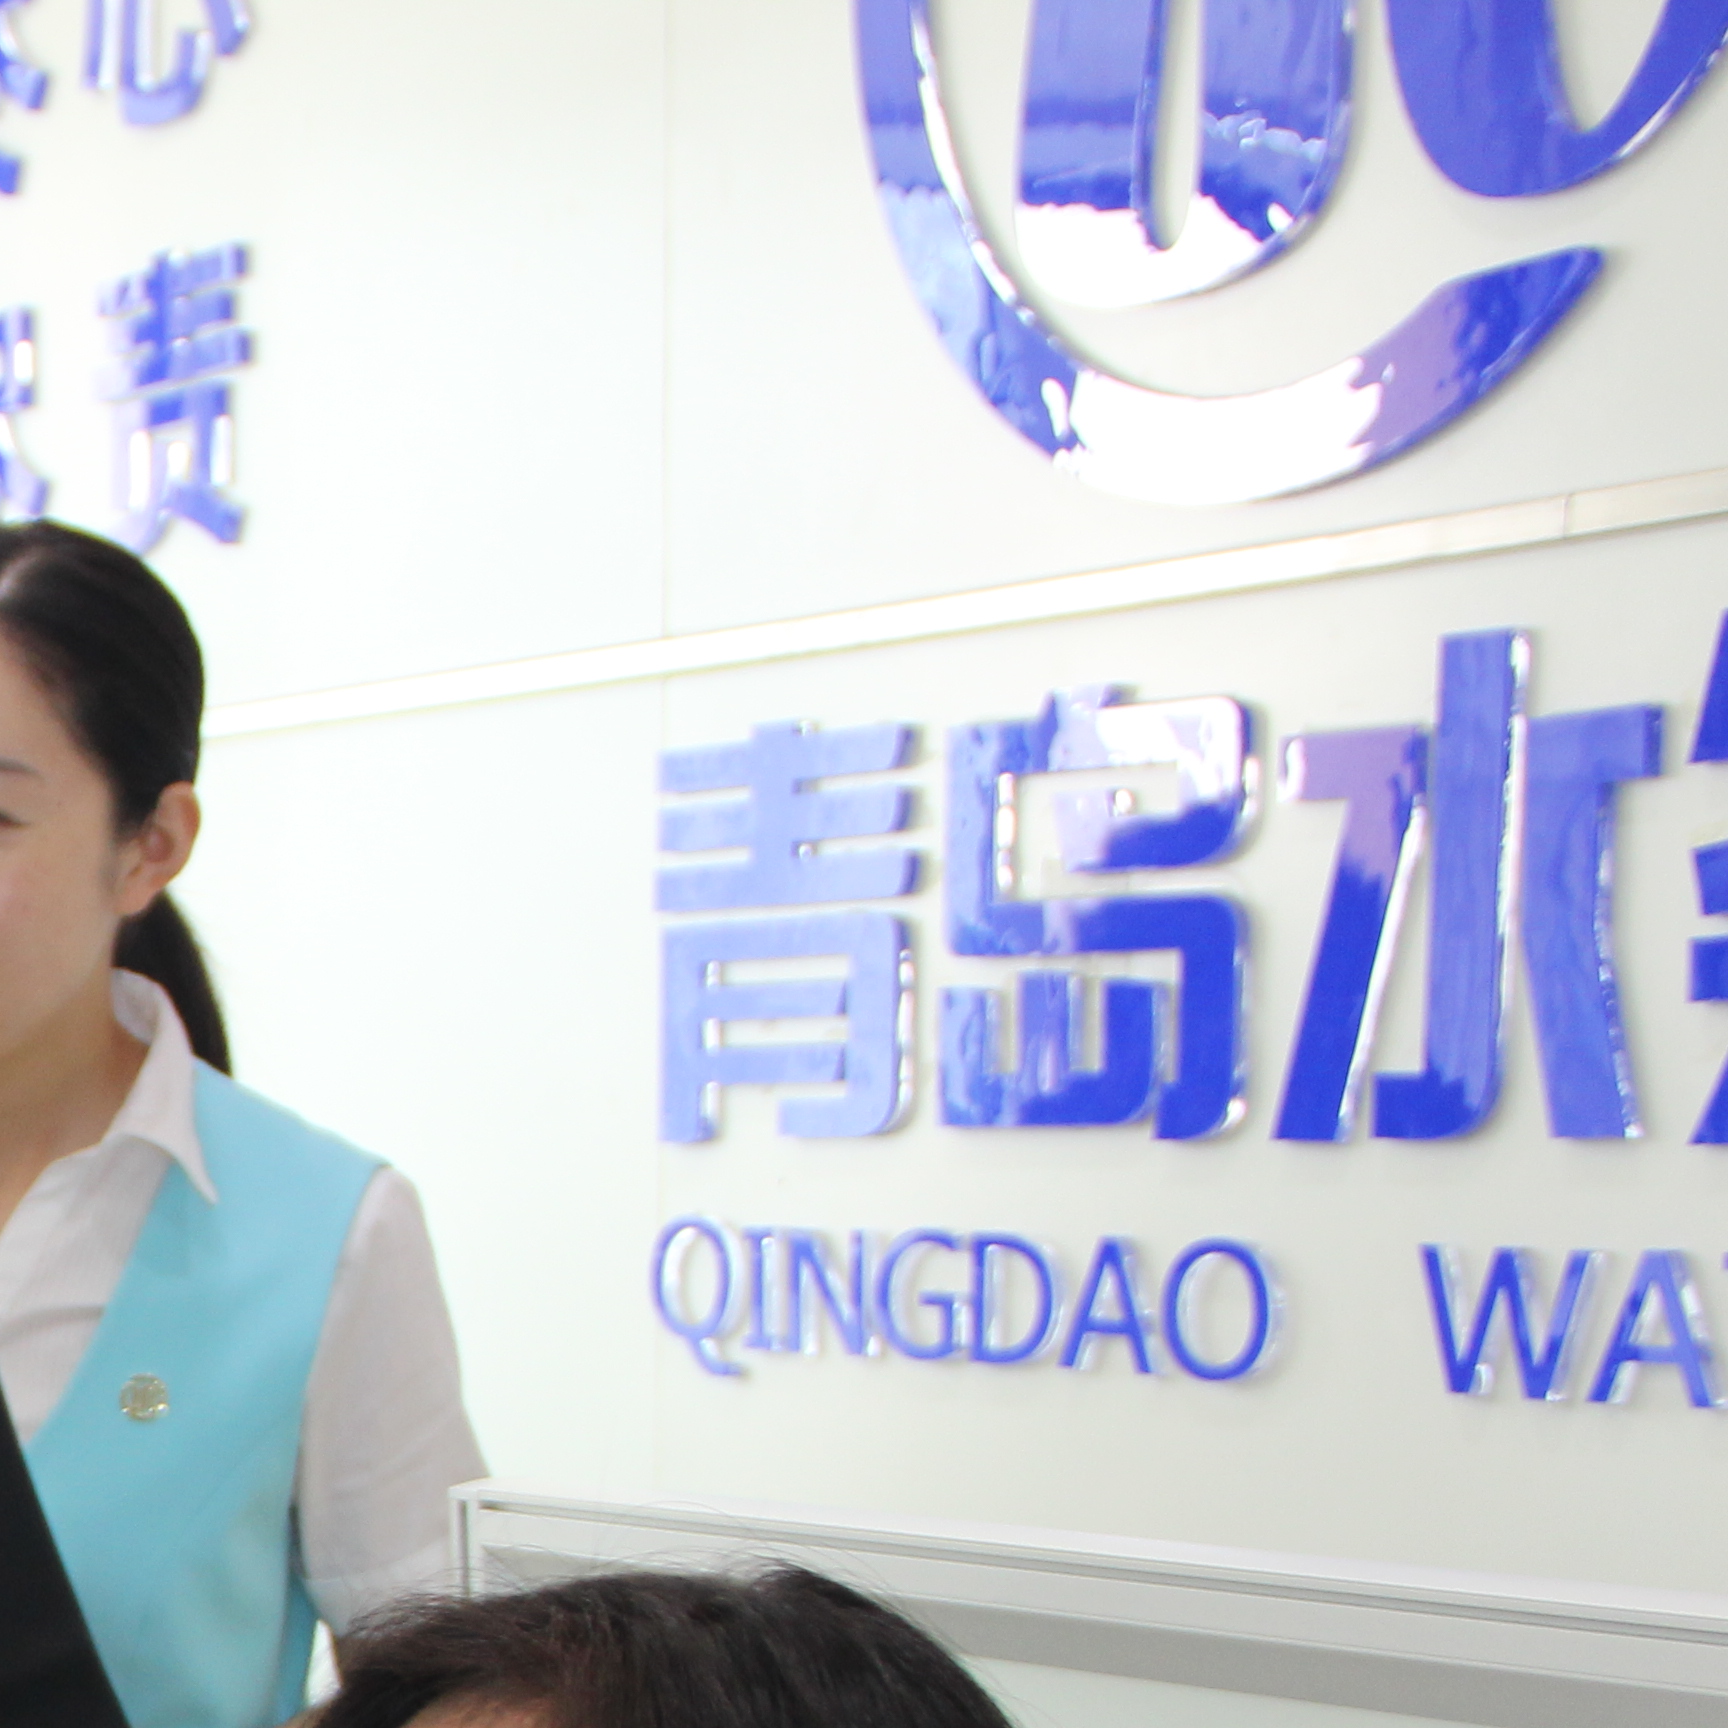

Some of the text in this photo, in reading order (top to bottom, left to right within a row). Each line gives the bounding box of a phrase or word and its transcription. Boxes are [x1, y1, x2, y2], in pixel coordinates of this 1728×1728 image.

[652, 608, 1728, 1145] 青岛水
[651, 1216, 1728, 1407] QINGDAO WA
